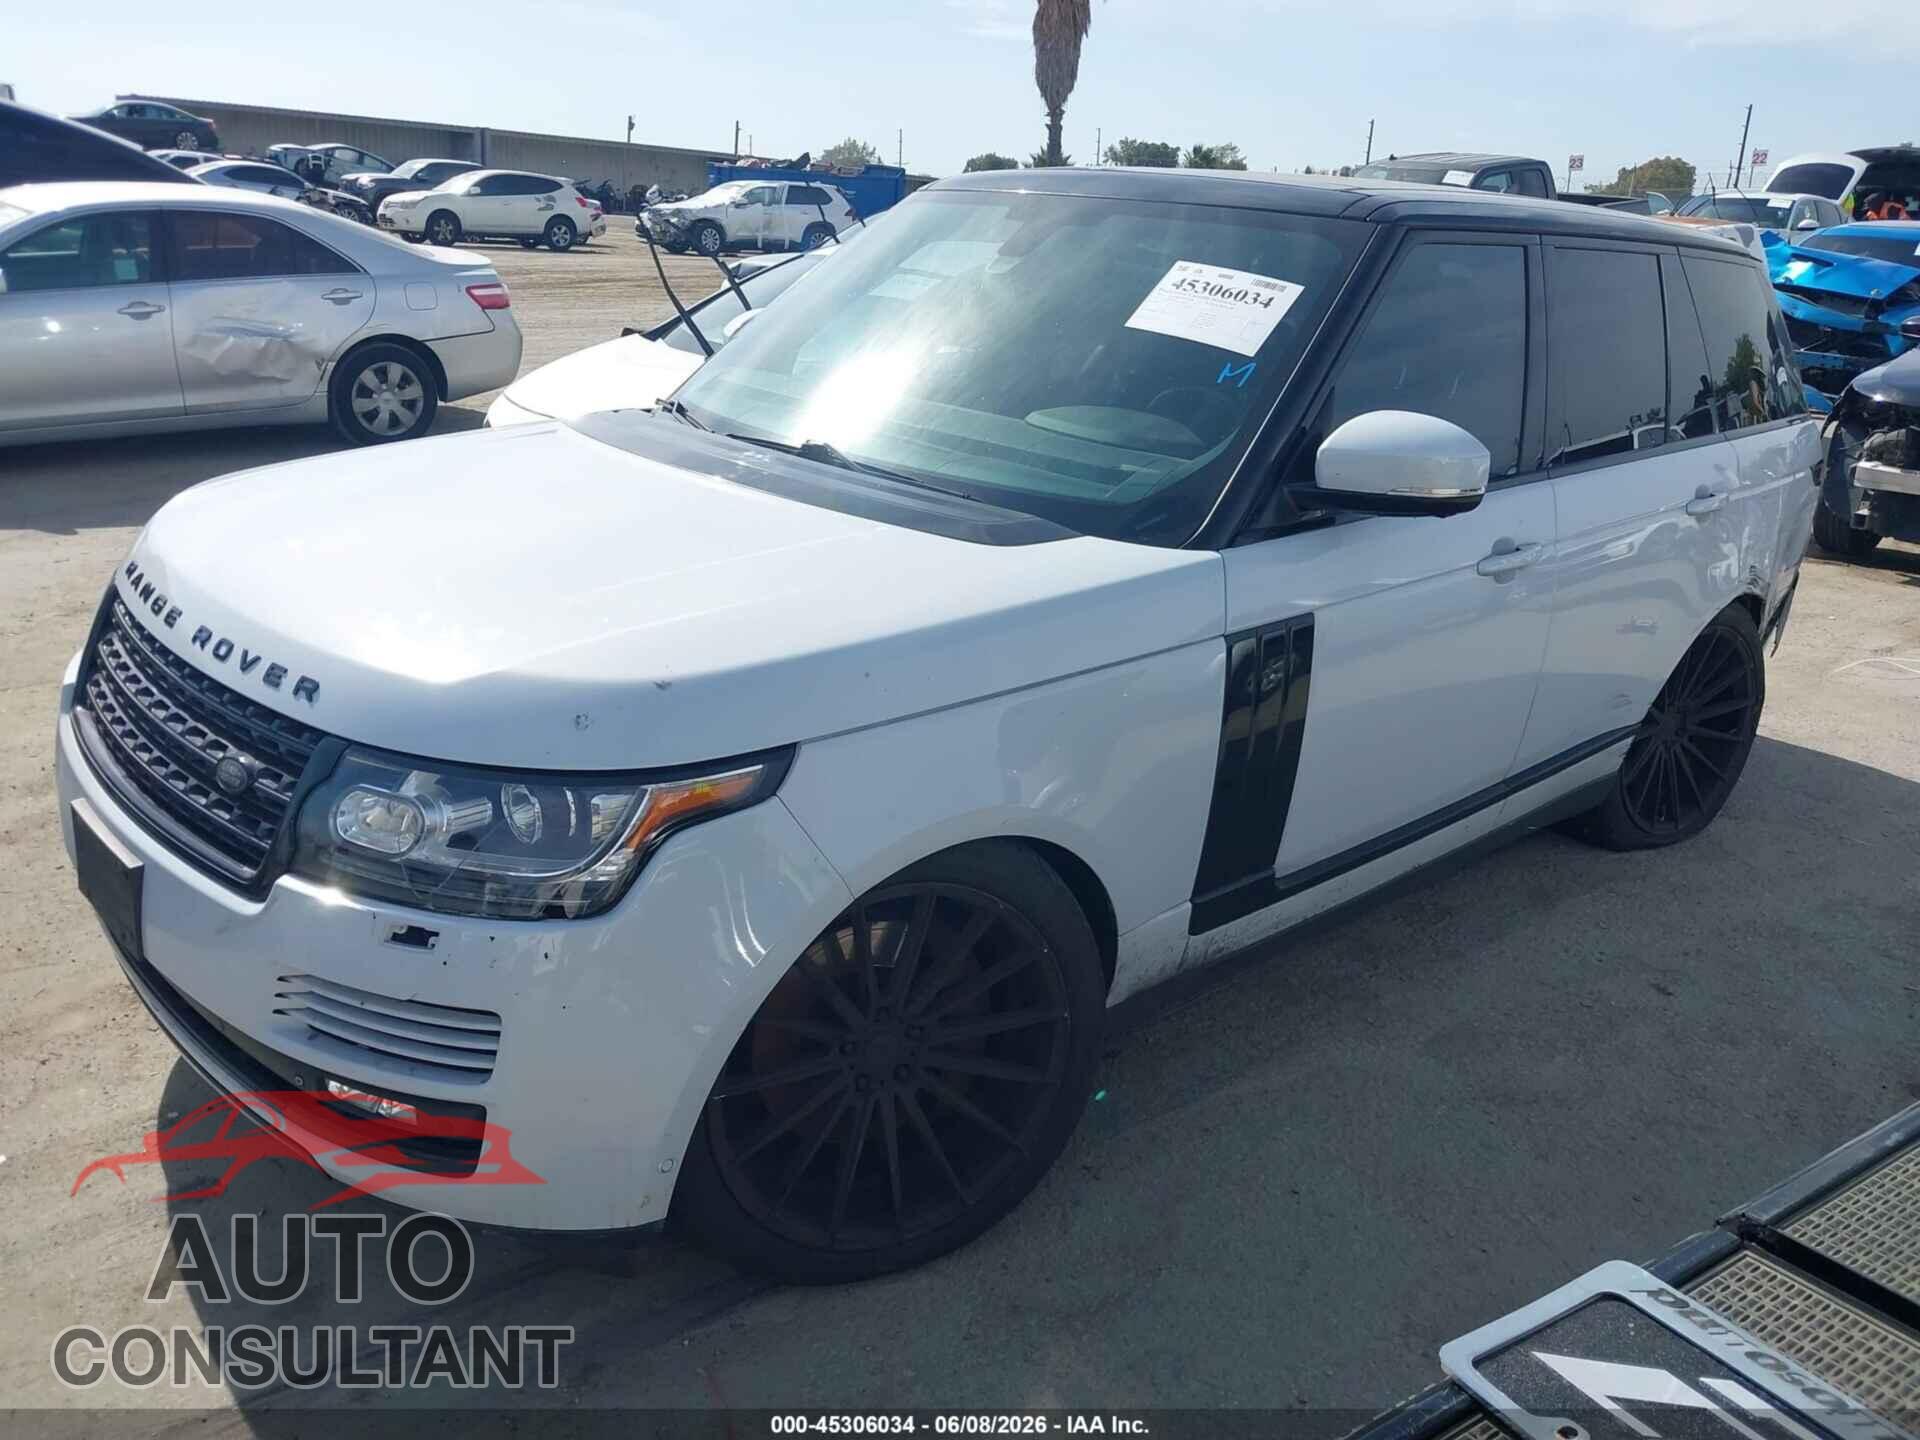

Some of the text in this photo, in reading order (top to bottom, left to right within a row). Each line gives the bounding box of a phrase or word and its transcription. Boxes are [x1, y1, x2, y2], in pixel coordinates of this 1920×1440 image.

[1569, 158, 1583, 168] 23
[1752, 152, 1767, 163] 22
[1171, 277, 1275, 309] 45306034
[125, 561, 321, 703] RANGE ROVER
